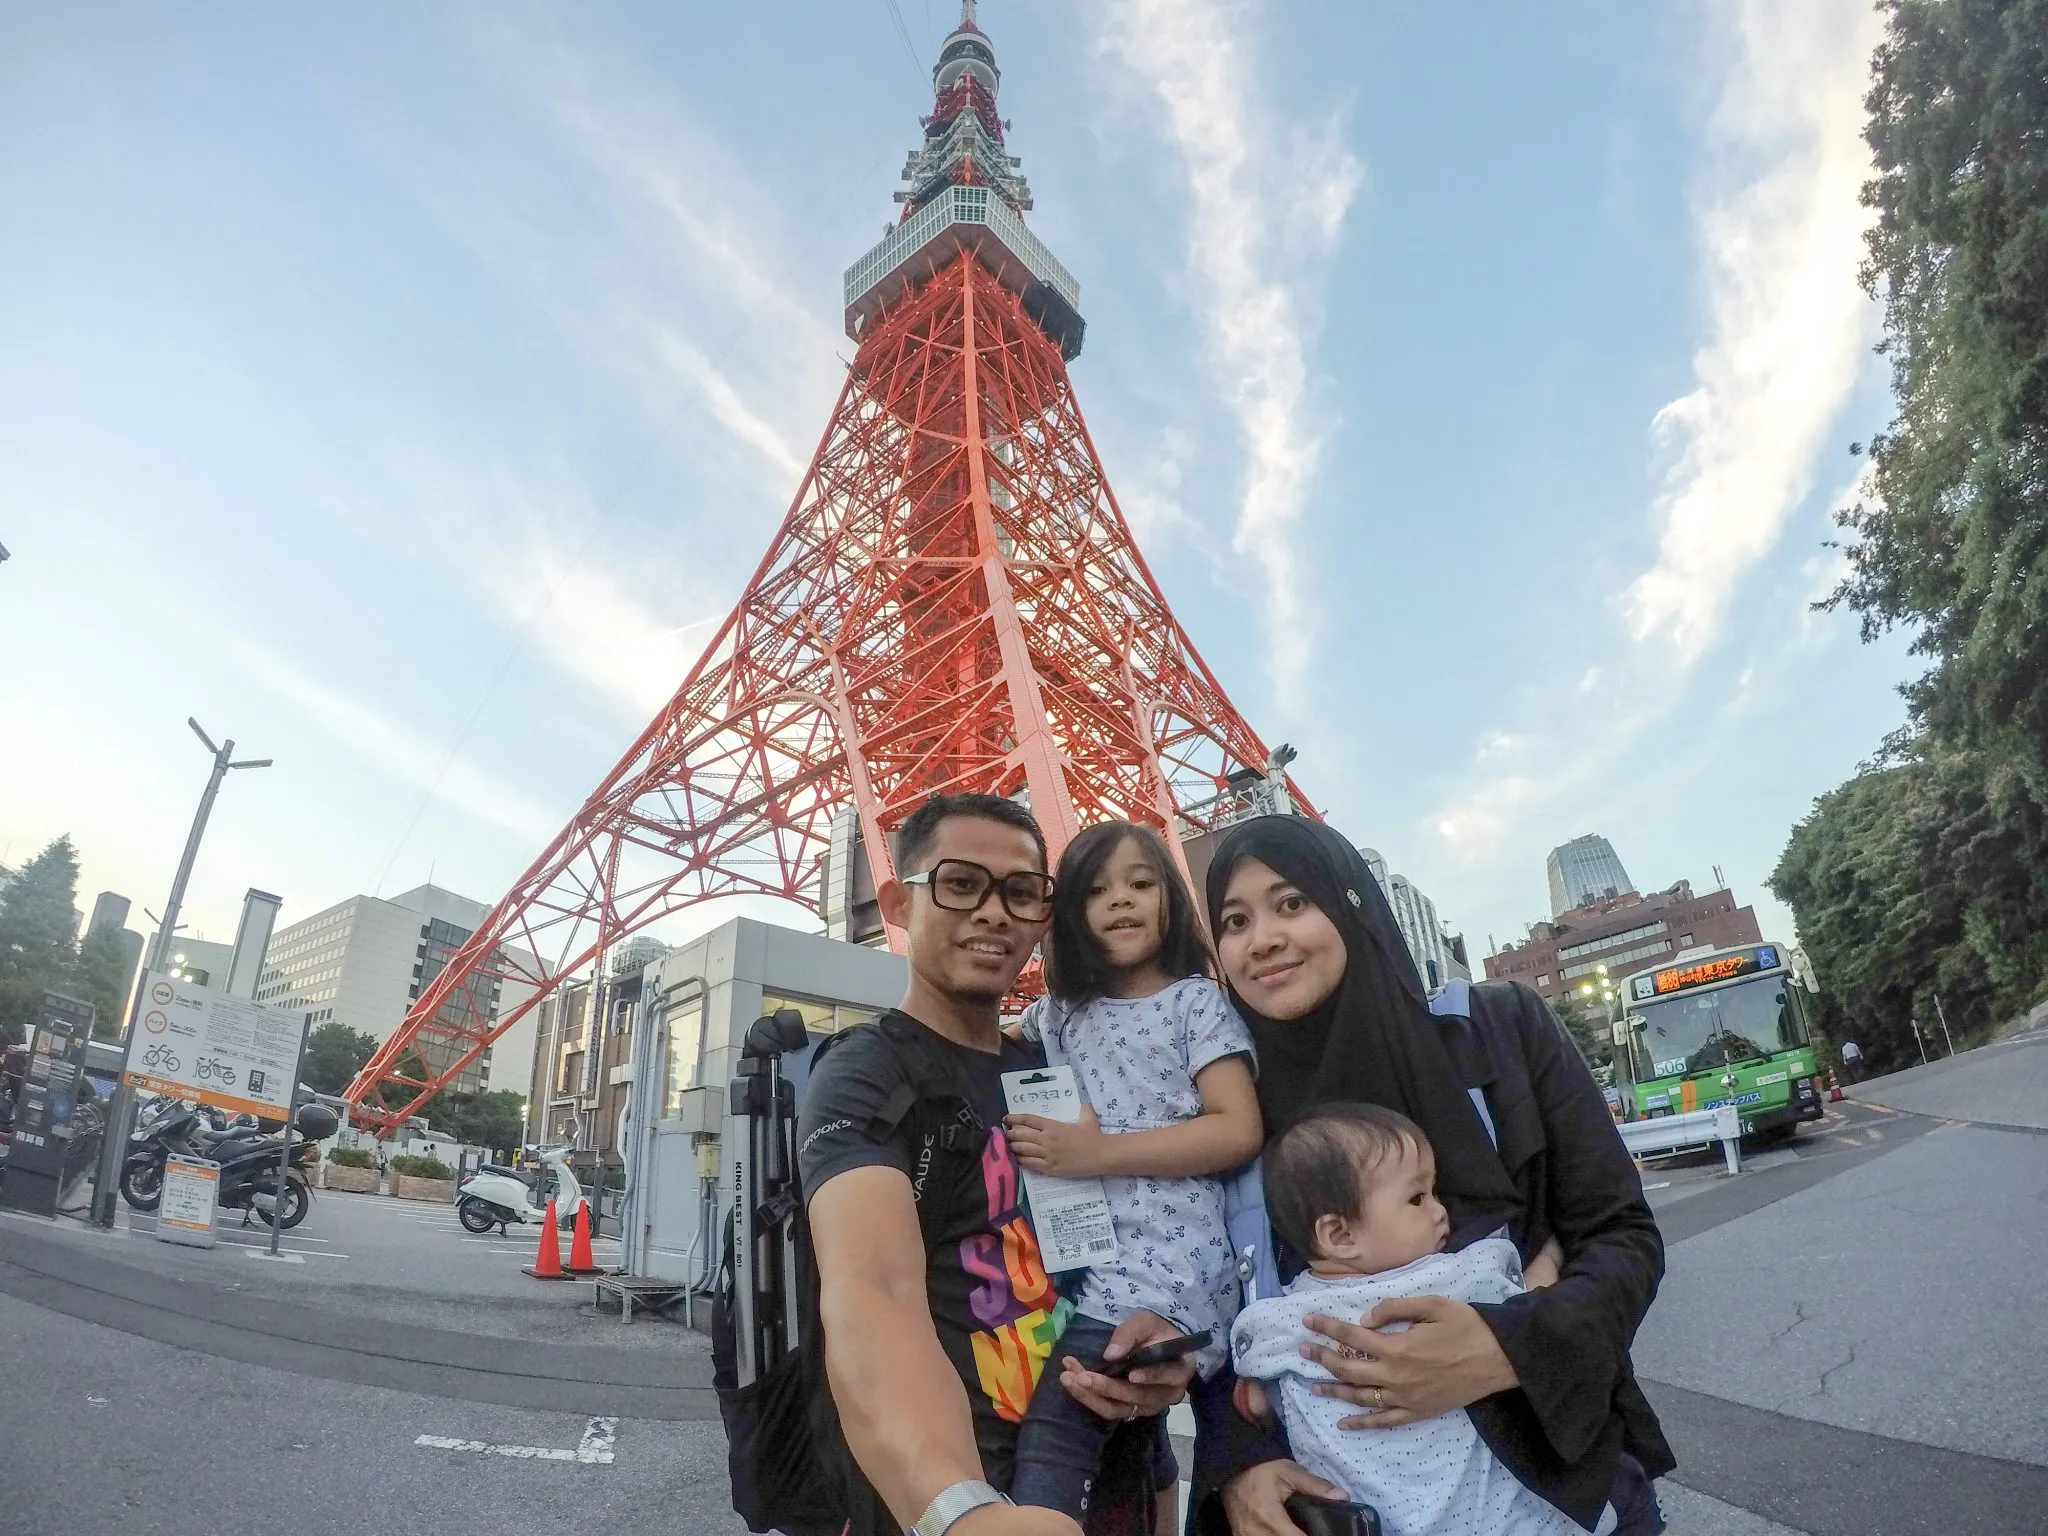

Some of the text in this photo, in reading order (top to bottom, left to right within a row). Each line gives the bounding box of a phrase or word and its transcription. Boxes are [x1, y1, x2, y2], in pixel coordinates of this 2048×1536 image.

[1703, 957, 1750, 977] 東京タワー
[1656, 1060, 1685, 1076] 506
[735, 1161, 743, 1192] KING
[913, 1133, 935, 1202] VAUDE
[735, 1195, 743, 1226] BEST
